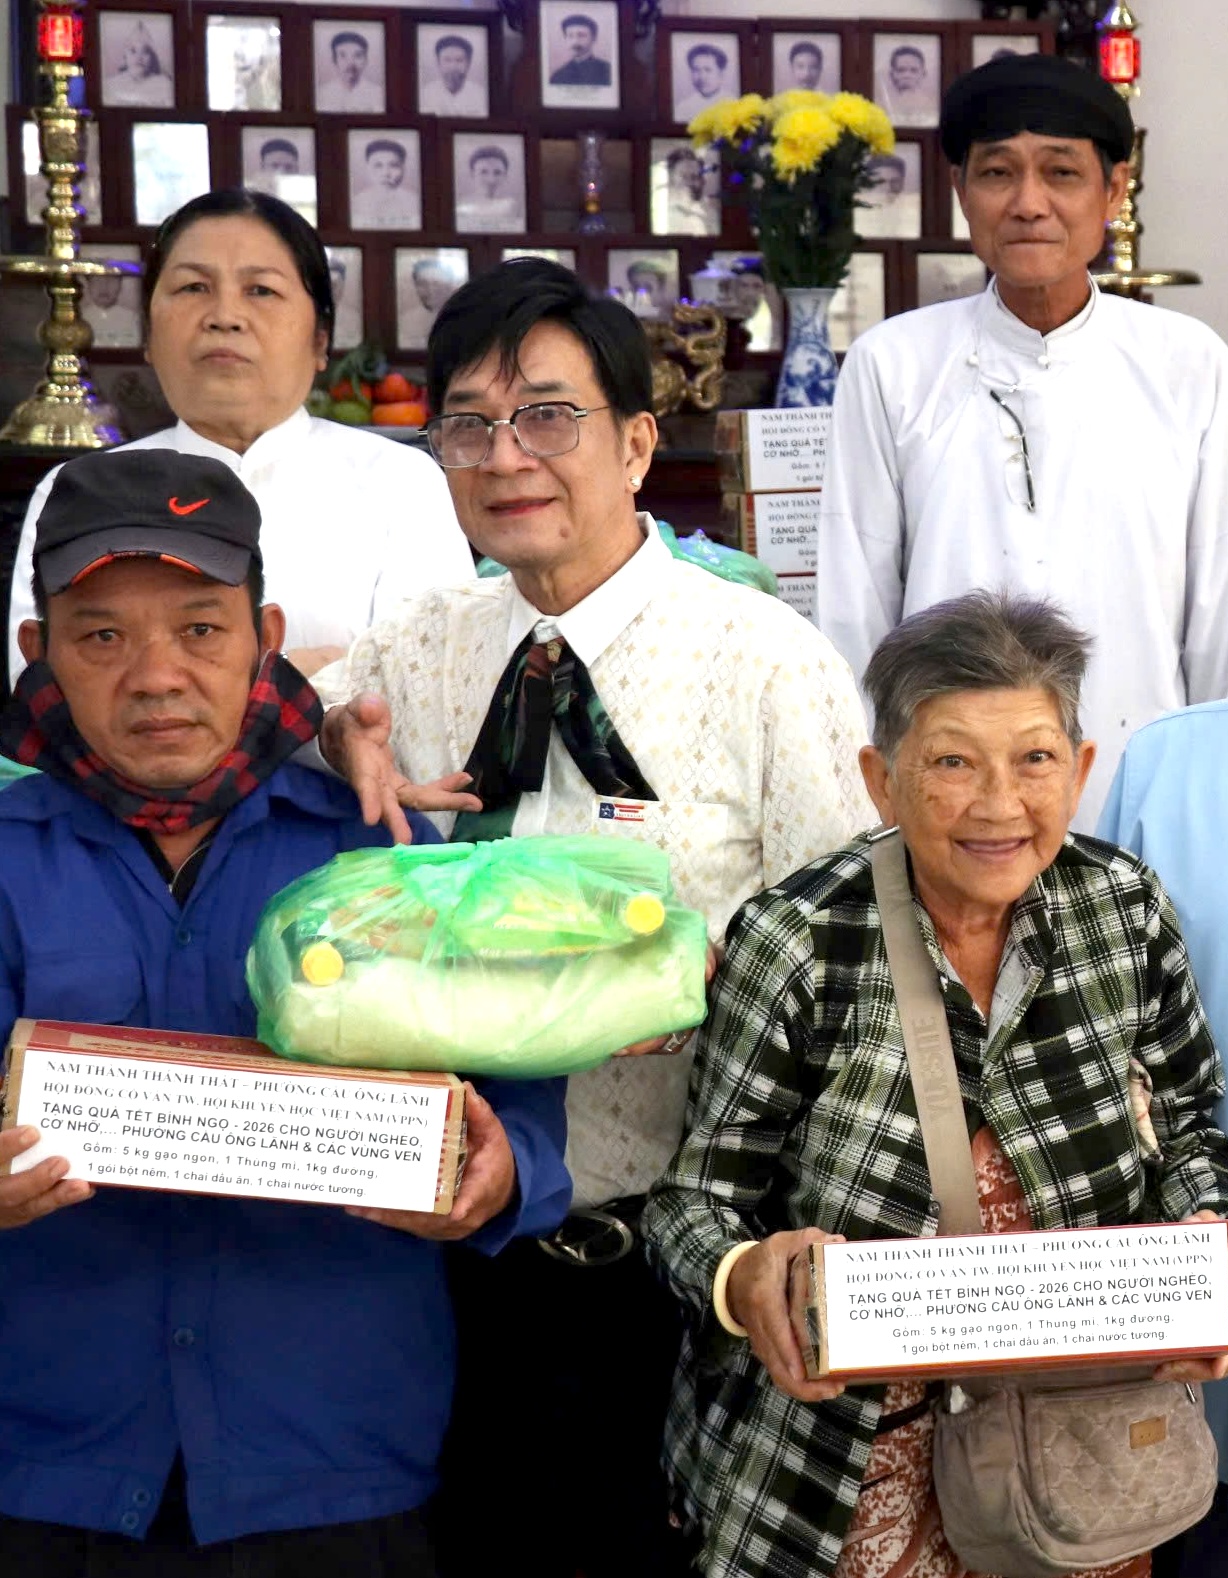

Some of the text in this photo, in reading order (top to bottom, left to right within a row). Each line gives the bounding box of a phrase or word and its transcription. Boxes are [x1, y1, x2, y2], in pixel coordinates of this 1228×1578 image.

[47, 1060, 81, 1074] NAM
[242, 1120, 275, 1134] 2026
[279, 1123, 311, 1137] CHO
[302, 1141, 313, 1153] &
[394, 1149, 422, 1162] VEN
[122, 1145, 130, 1156] 5
[134, 1146, 150, 1160] kg
[225, 1155, 231, 1165] 1
[306, 1162, 328, 1176] 1kg
[87, 1162, 93, 1172] 1
[174, 1169, 180, 1179] 1
[183, 1170, 209, 1182] chai
[257, 1177, 263, 1186] 1
[266, 1178, 291, 1189] chai
[1038, 1281, 1069, 1294] 2026
[1073, 1279, 1103, 1292] CHO
[1098, 1294, 1108, 1306] &
[1184, 1289, 1212, 1301] VEN
